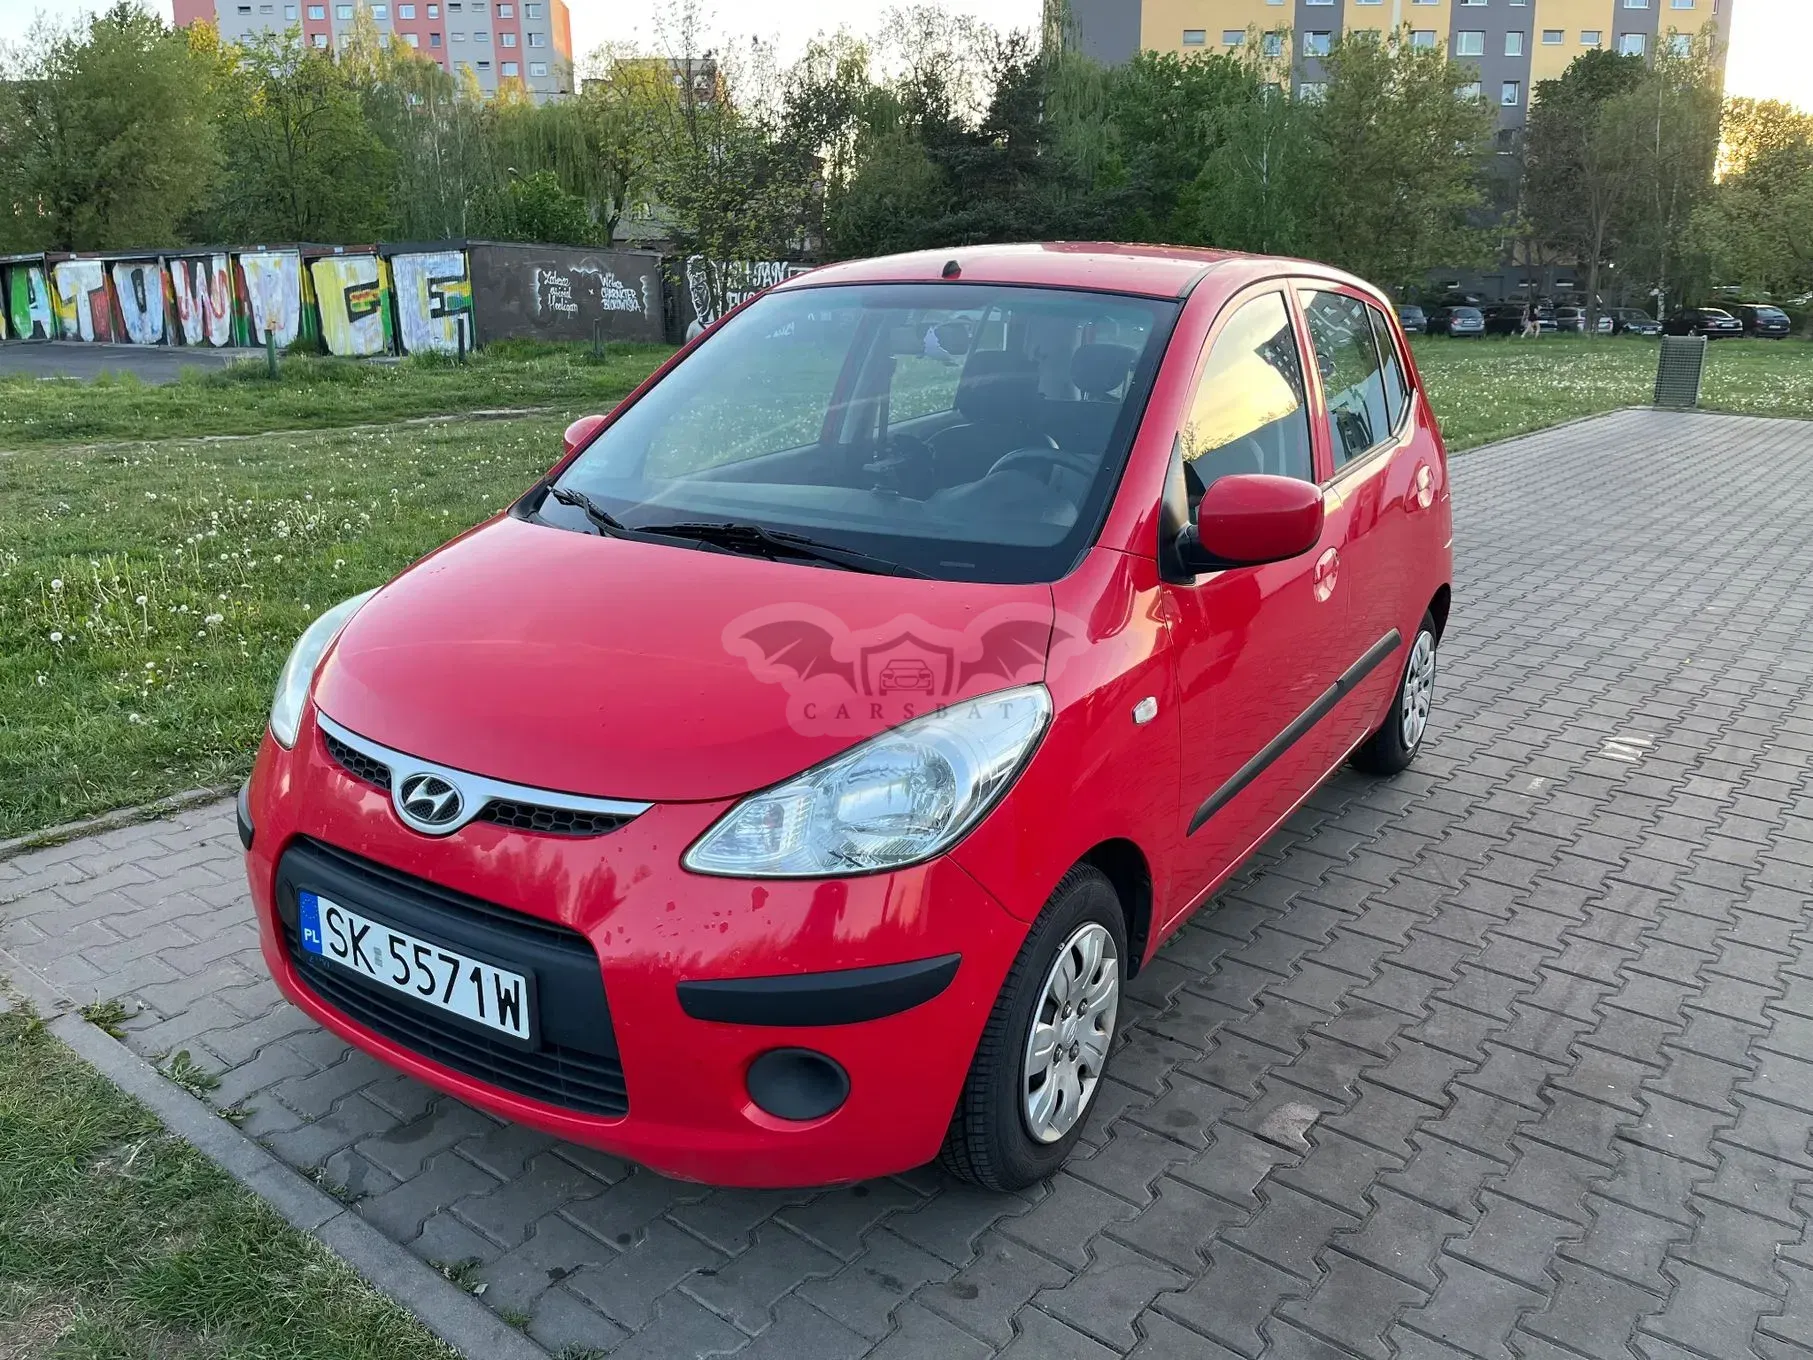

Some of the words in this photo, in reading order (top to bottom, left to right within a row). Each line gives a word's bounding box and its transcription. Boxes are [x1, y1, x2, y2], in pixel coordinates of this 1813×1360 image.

[0, 252, 473, 356] ATOWICE
[304, 927, 320, 944] PL
[326, 907, 376, 975] SK
[388, 933, 520, 1032] 5571W
